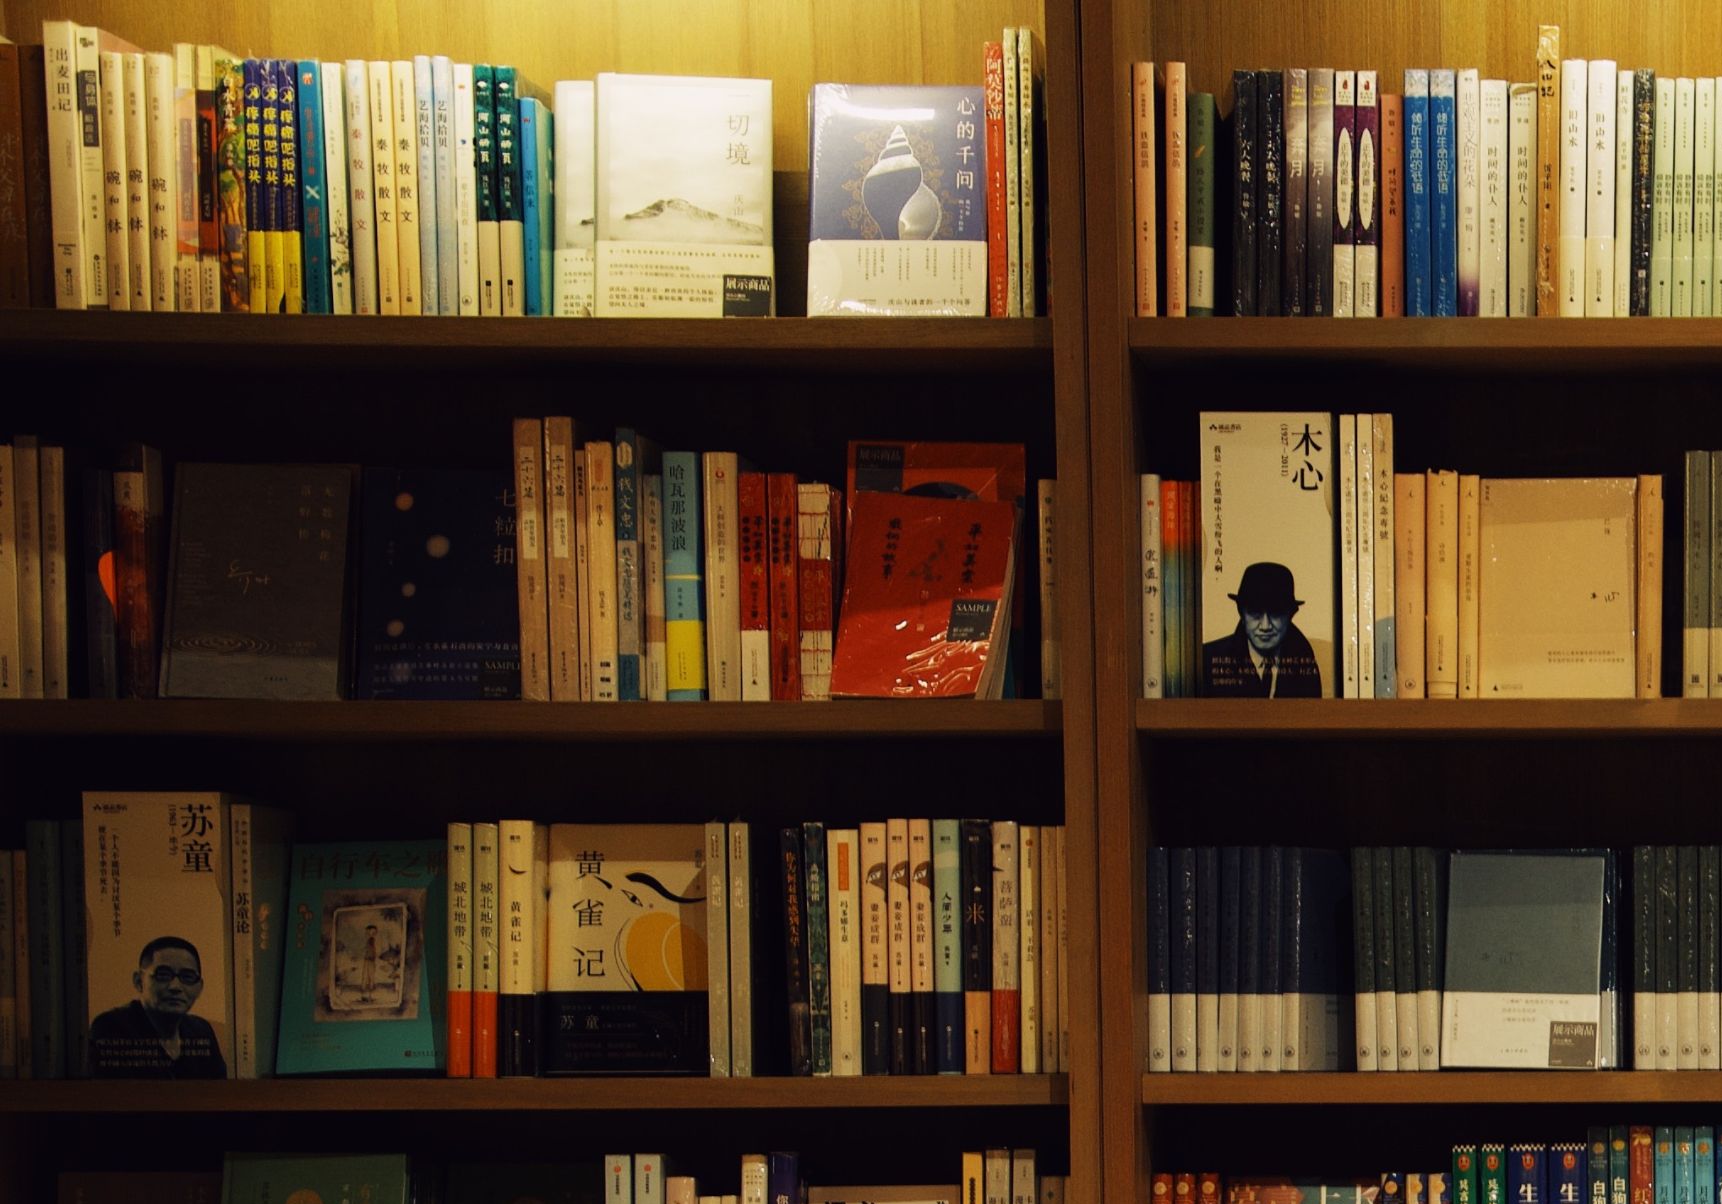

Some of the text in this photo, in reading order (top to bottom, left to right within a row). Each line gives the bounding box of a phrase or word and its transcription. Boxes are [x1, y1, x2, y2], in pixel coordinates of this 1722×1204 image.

[55, 47, 72, 112] 出麦田记
[418, 98, 431, 149] 艺海拾贝
[955, 97, 976, 191] 心的千问
[1567, 108, 1580, 148] 旧山水
[352, 127, 369, 231] 秦牧散文
[376, 138, 392, 223] 秦牧散文
[1486, 143, 1500, 207] 时间的仆人
[725, 275, 771, 292] 展示商品
[1291, 423, 1324, 492] 木心
[670, 465, 687, 550] 哈瓦那波浪
[955, 603, 992, 613] SAMPLE
[181, 804, 214, 873] 苏童
[235, 892, 250, 934] 苏童论
[452, 882, 466, 938] 城北地带
[479, 882, 494, 938] 城北地带
[509, 902, 522, 943] 黄雀记
[572, 850, 614, 978] 黄雀记
[966, 903, 985, 925] 米
